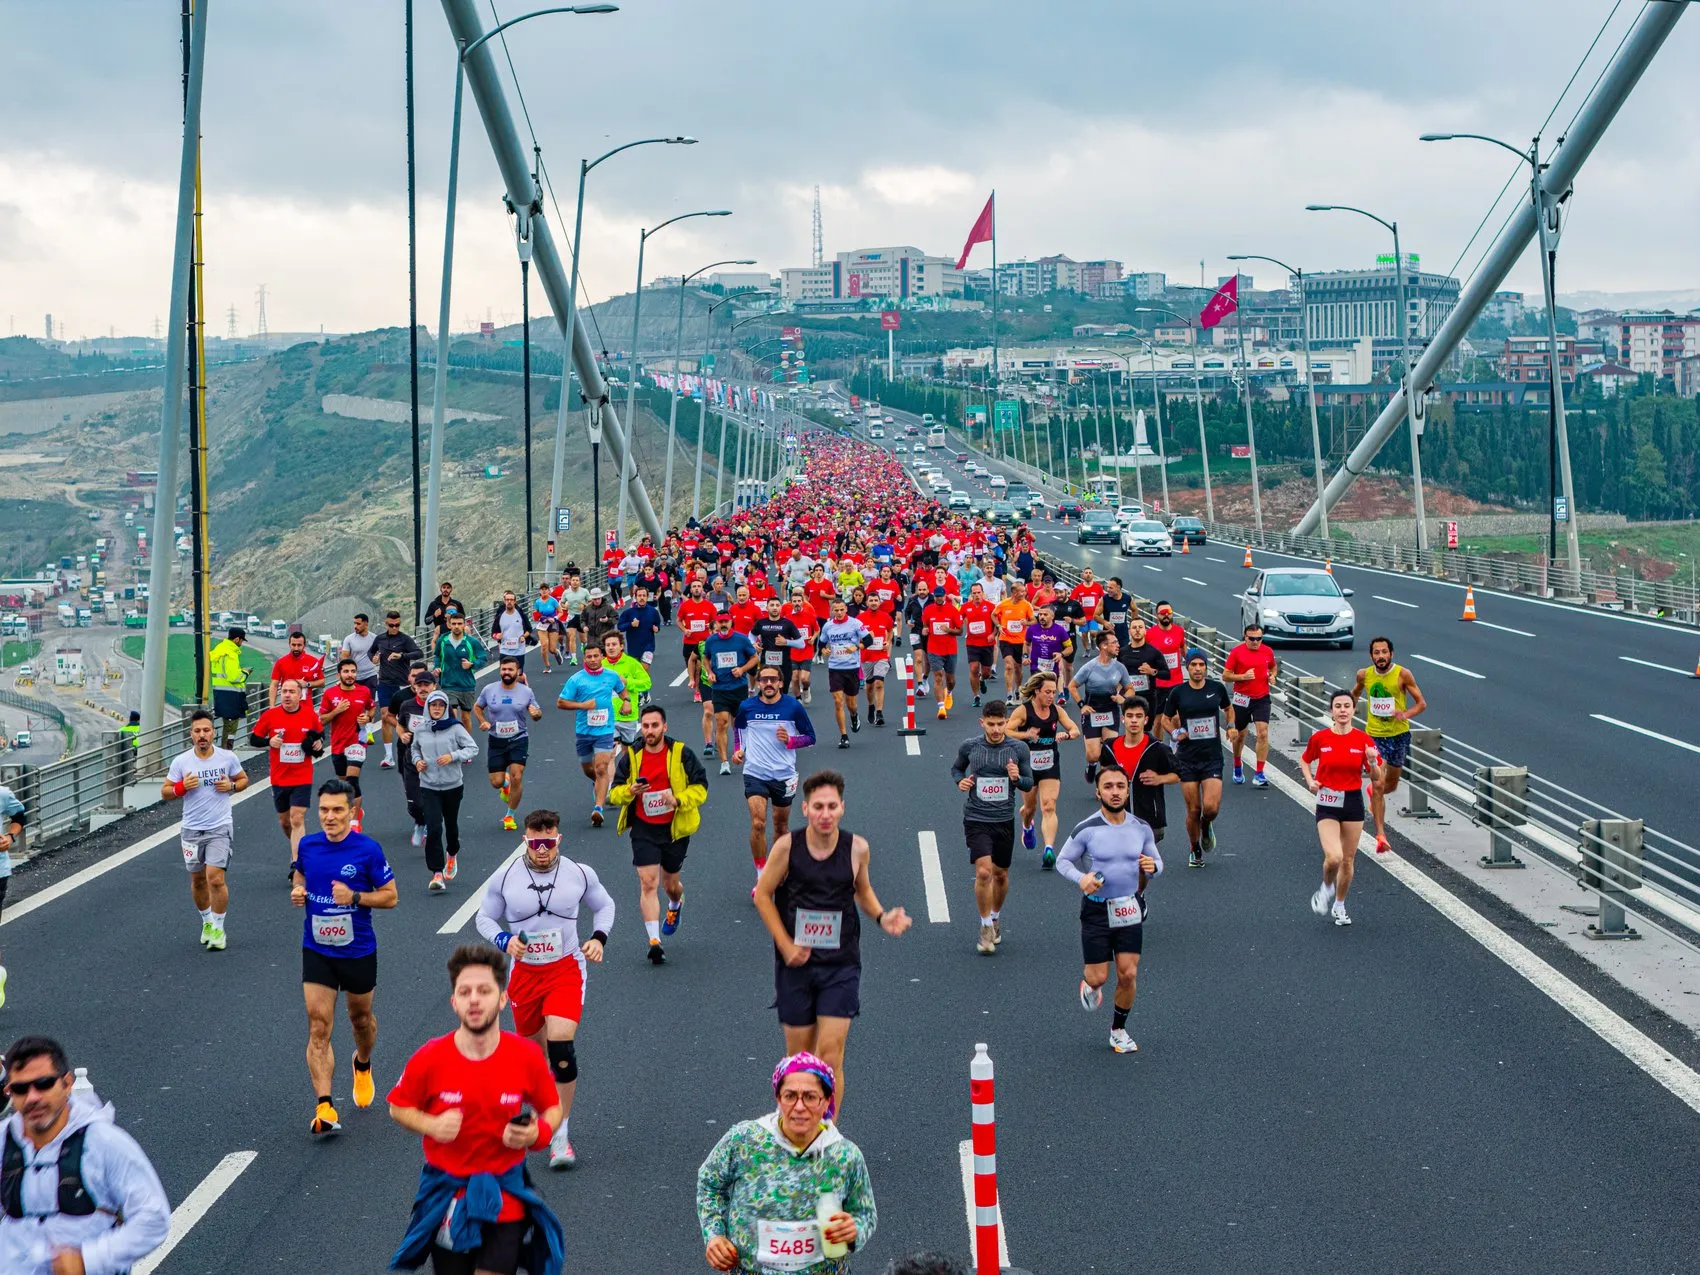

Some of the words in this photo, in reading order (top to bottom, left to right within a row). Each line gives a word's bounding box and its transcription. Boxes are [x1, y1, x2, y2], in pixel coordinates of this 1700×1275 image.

[1193, 724, 1210, 733] 6126
[284, 749, 301, 757] 4681
[1033, 757, 1051, 765] 4422
[198, 769, 219, 778] LIEVE
[982, 785, 1003, 793] 4801
[1319, 793, 1338, 803] 5187
[319, 926, 346, 937] 4996
[804, 922, 833, 936] 5973
[527, 942, 554, 954] 6314
[770, 1238, 815, 1256] 5485
